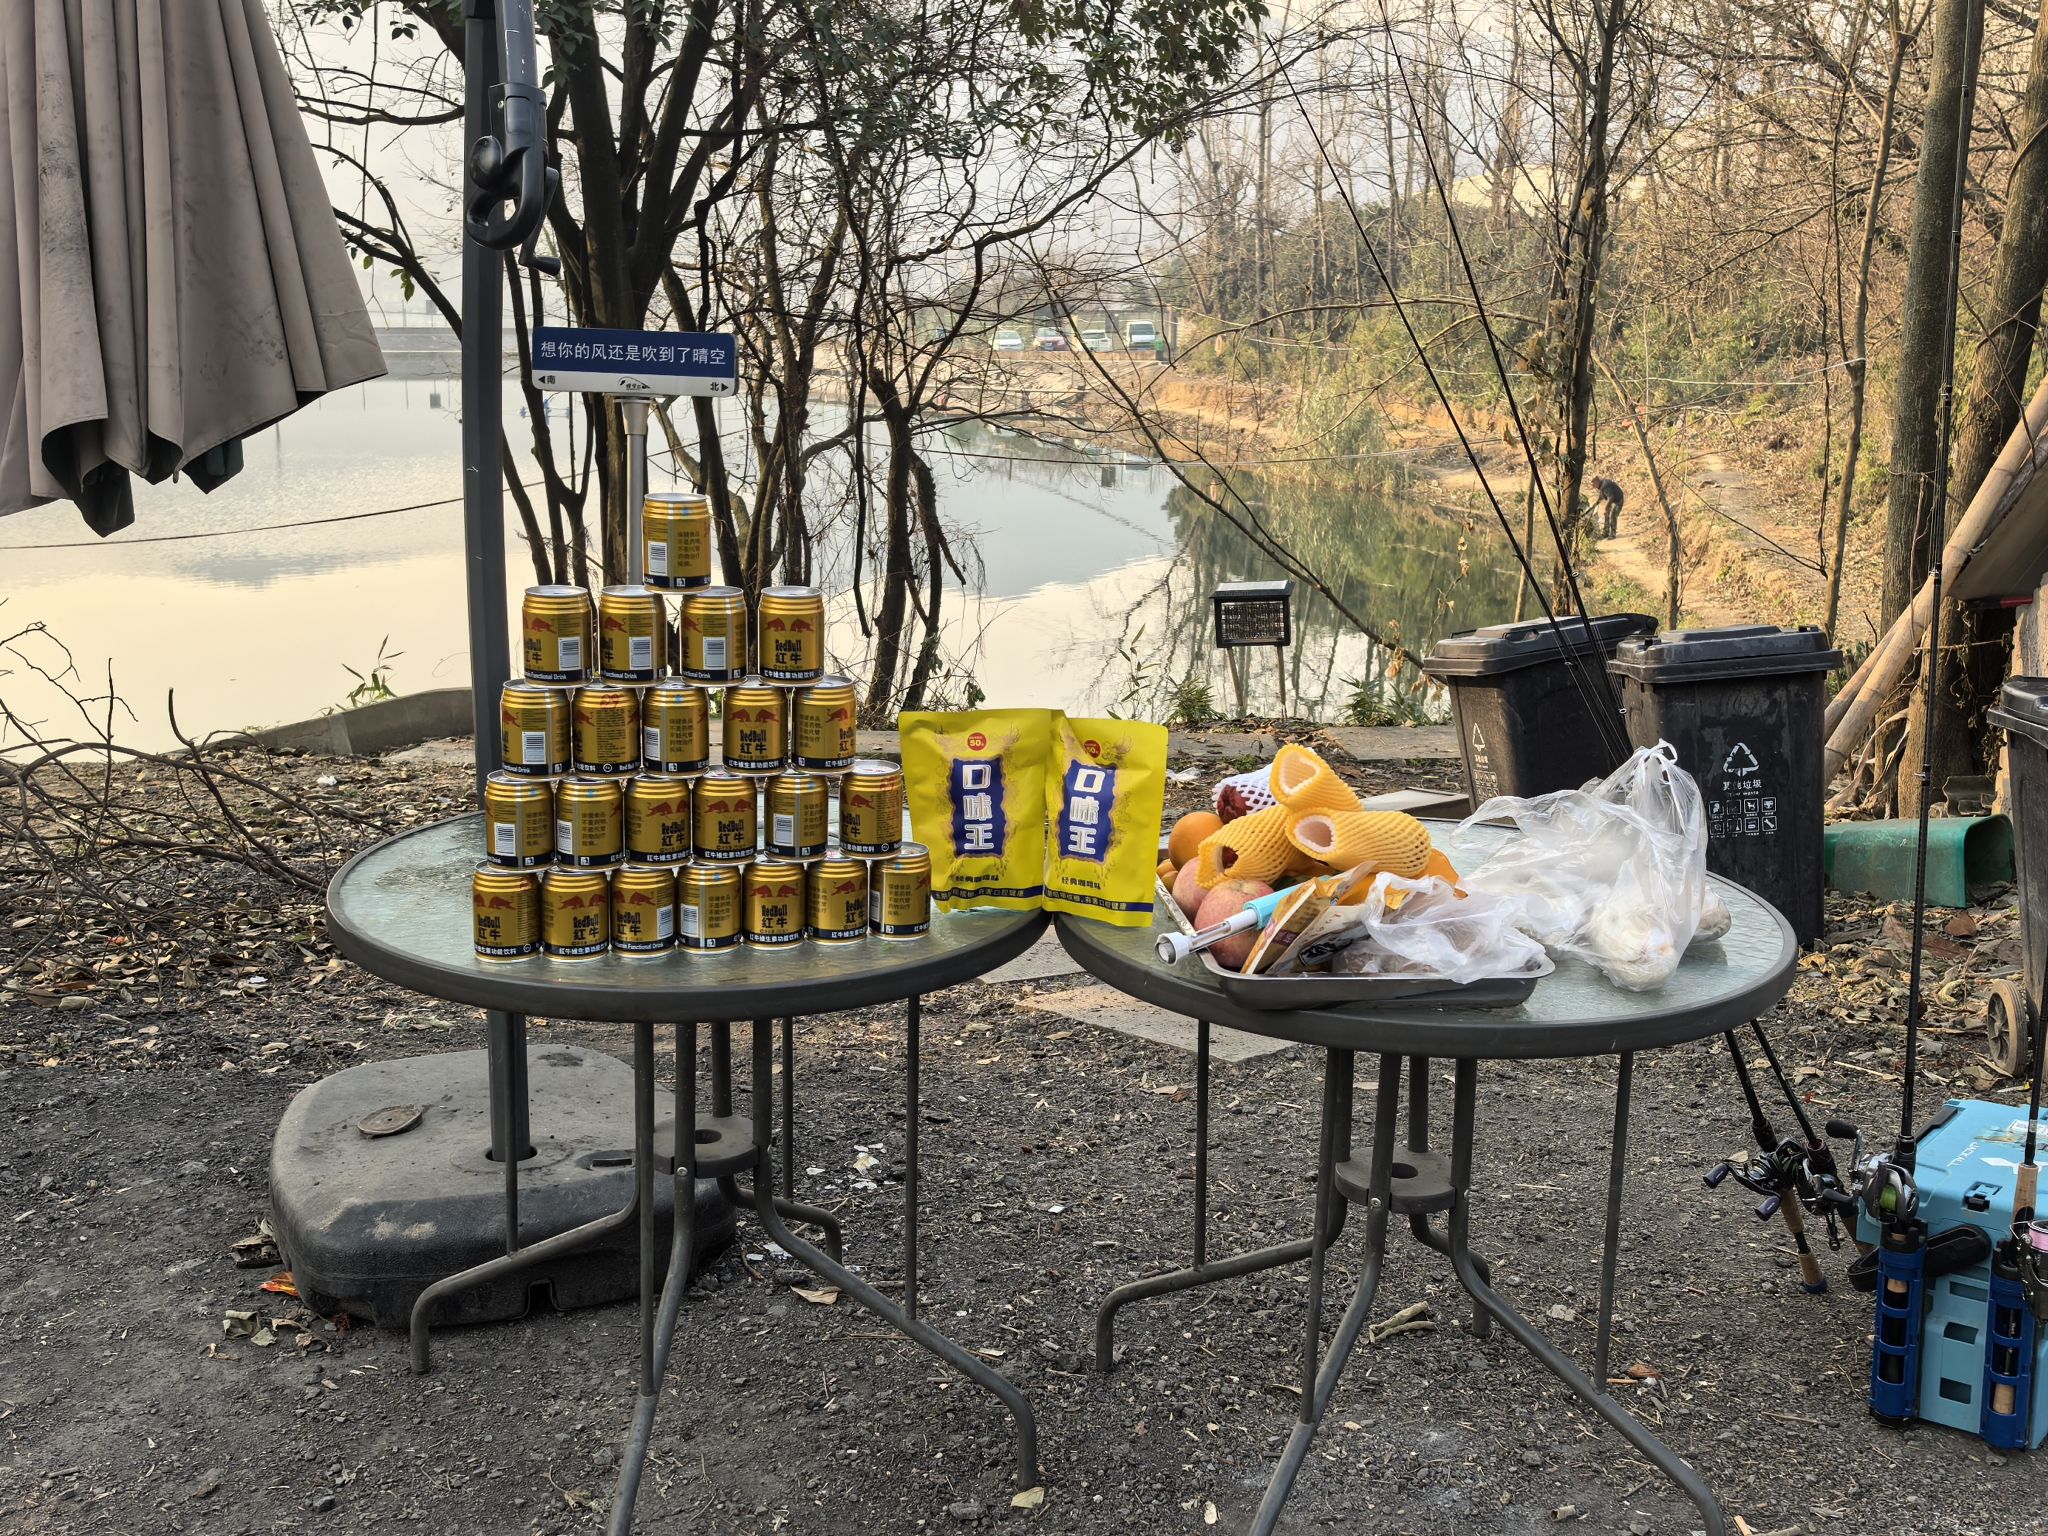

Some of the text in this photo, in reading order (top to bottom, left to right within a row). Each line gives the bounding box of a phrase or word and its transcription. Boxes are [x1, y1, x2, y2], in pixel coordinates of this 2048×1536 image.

[541, 341, 726, 365] 想你的风还是吹到了晴空
[710, 382, 719, 391] 北
[776, 639, 801, 652] RedBull
[776, 652, 802, 664] 红牛
[740, 730, 766, 741] RedBull
[740, 742, 767, 755] 红牛
[962, 764, 994, 850] 口味王
[1067, 768, 1106, 855] 口味王
[718, 819, 744, 833] RedBull
[718, 833, 744, 845] 红牛
[762, 904, 787, 917] RedBull
[762, 917, 787, 929] 红牛
